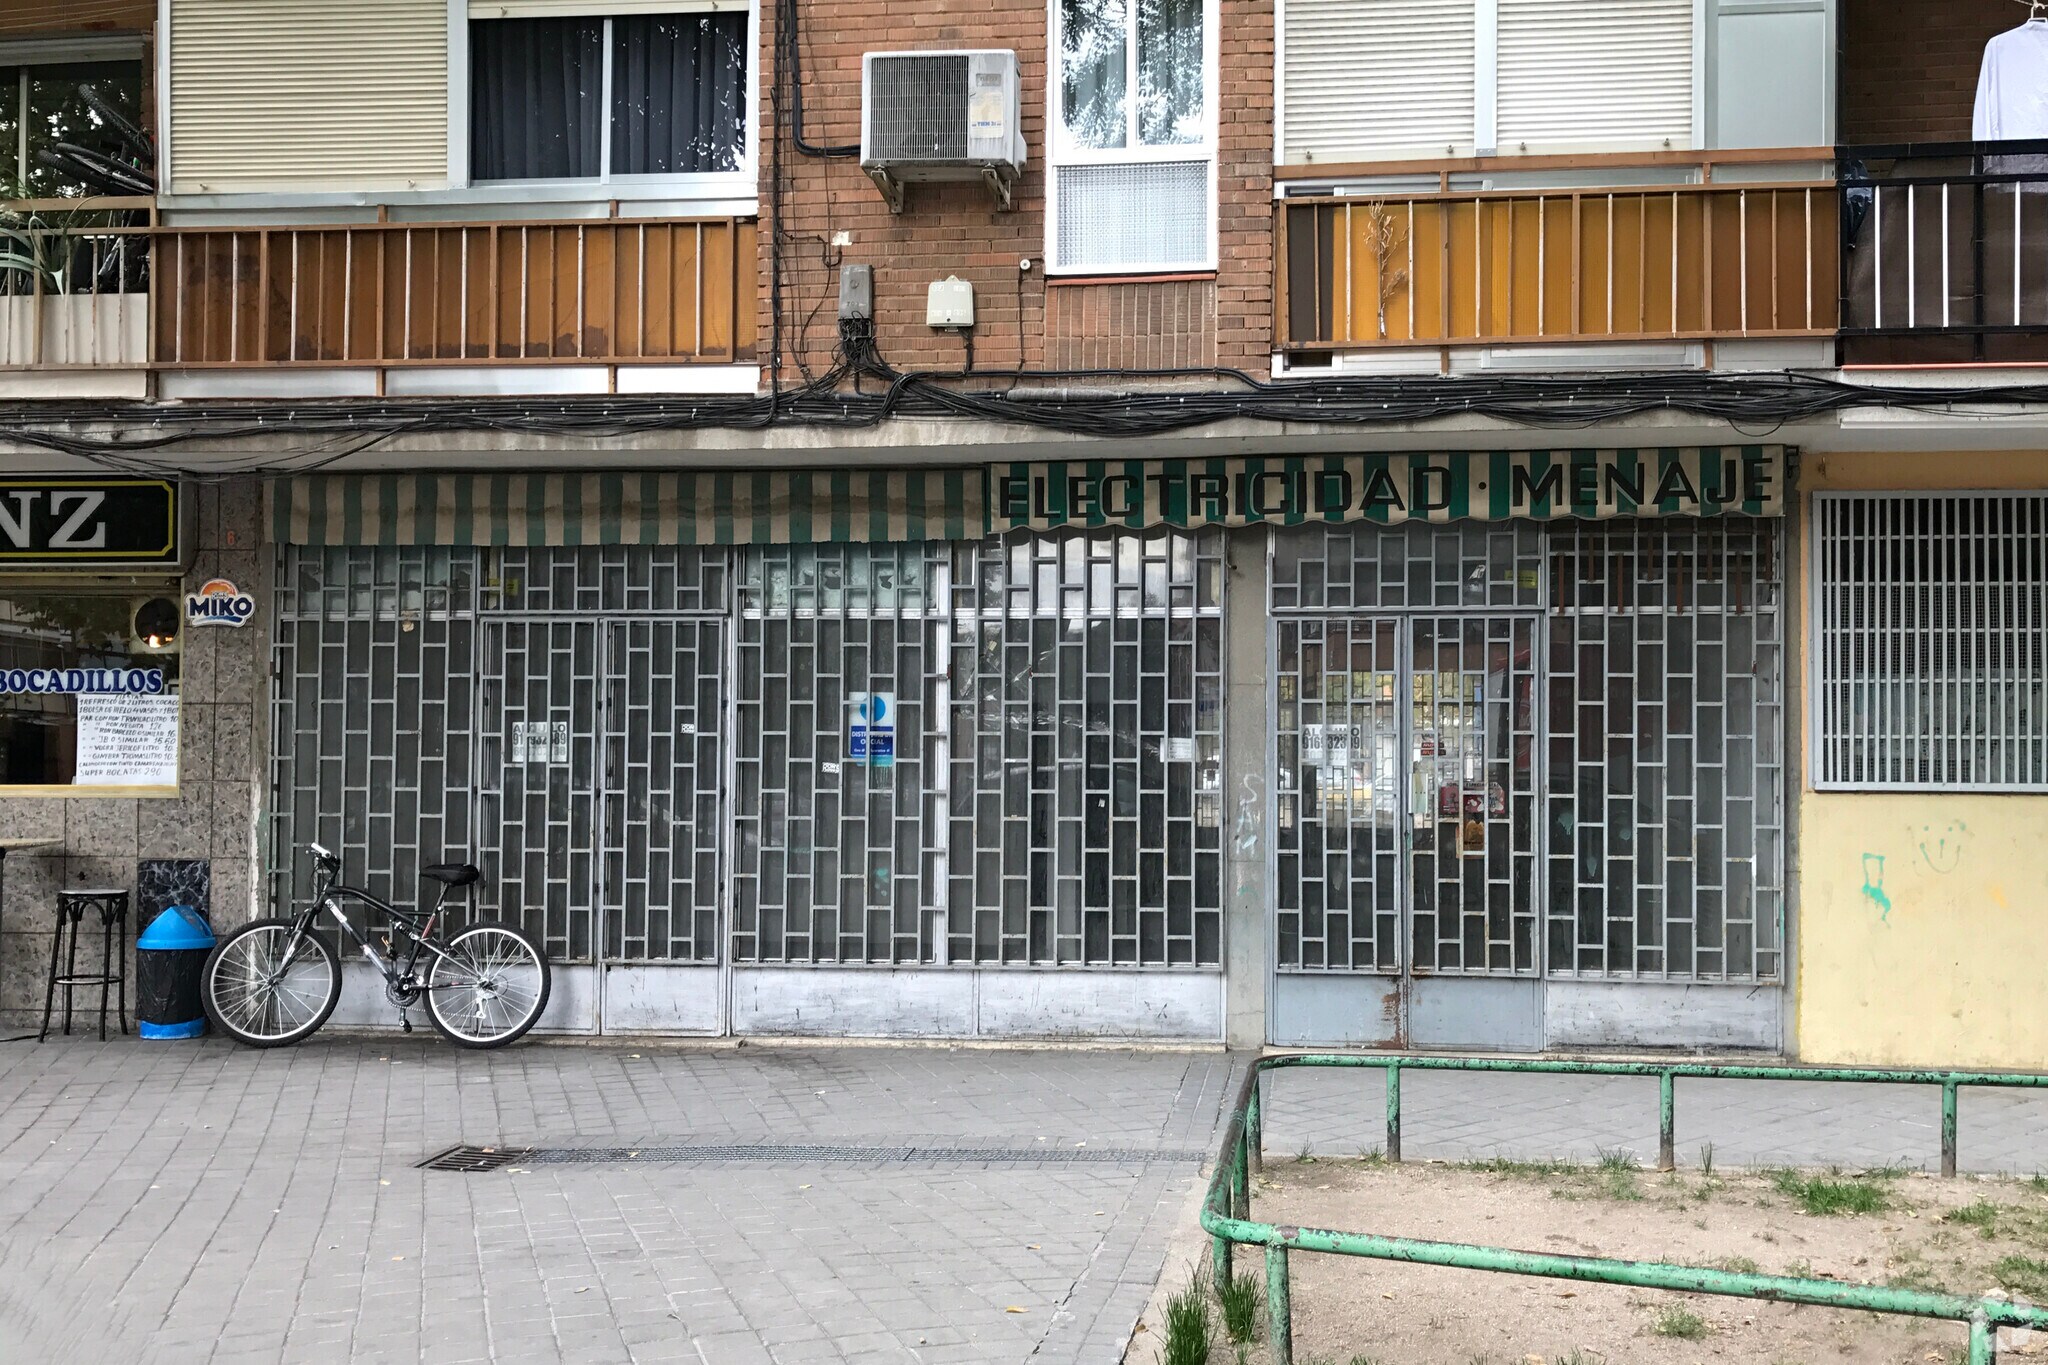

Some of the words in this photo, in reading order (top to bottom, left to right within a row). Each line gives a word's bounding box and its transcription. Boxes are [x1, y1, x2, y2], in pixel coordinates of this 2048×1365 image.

[1001, 466, 1451, 519] ELECTRICIDAD
[1511, 458, 1773, 508] MENAJE
[189, 597, 253, 617] MIKO
